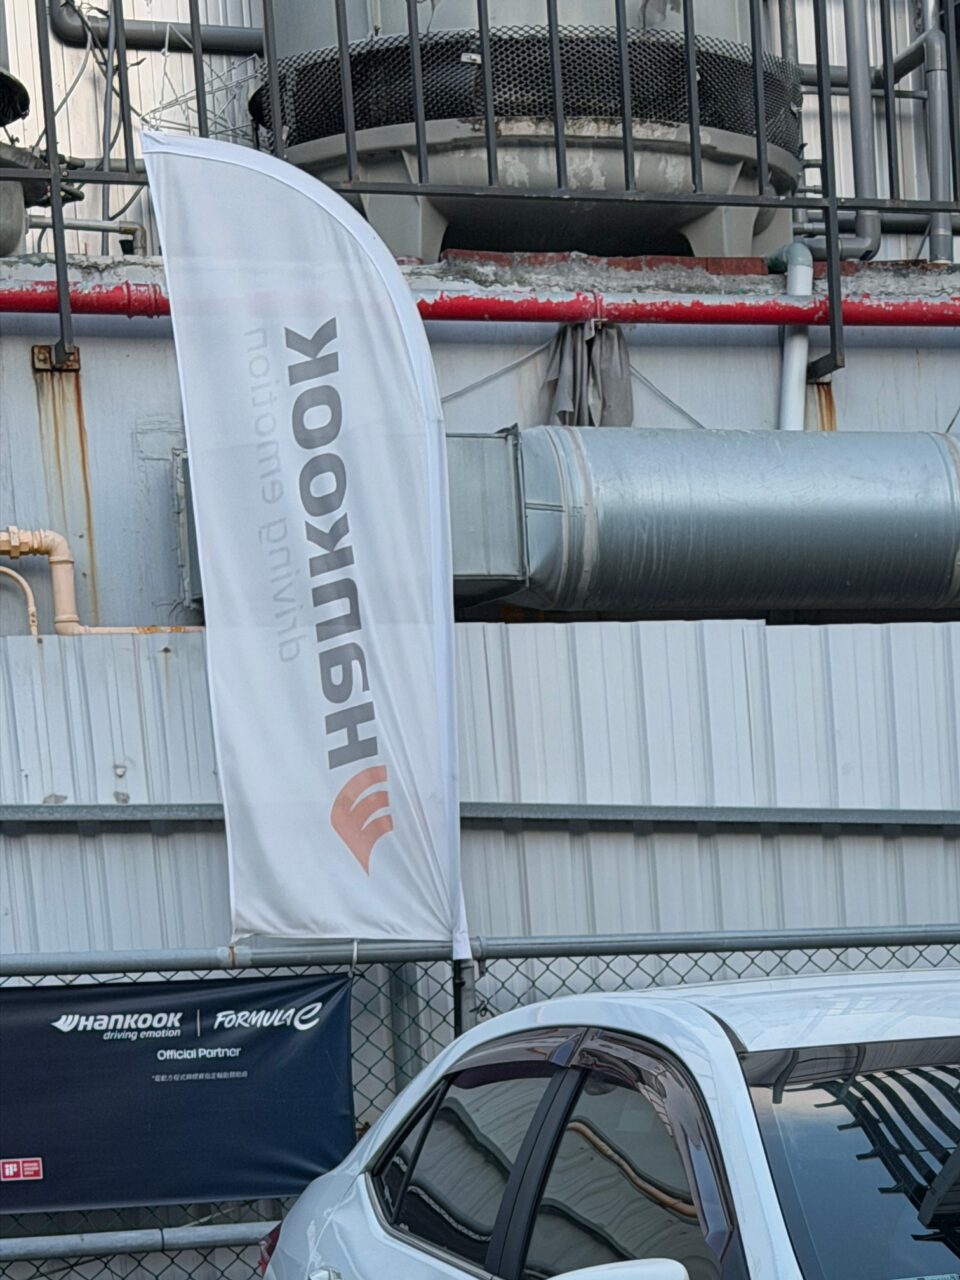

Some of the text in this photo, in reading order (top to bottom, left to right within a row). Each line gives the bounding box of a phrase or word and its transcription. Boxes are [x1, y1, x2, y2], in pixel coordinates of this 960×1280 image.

[213, 1007, 296, 1030] FORMULA
[102, 1028, 181, 1041] driving emotion
[157, 1047, 242, 1060] Official Partner
